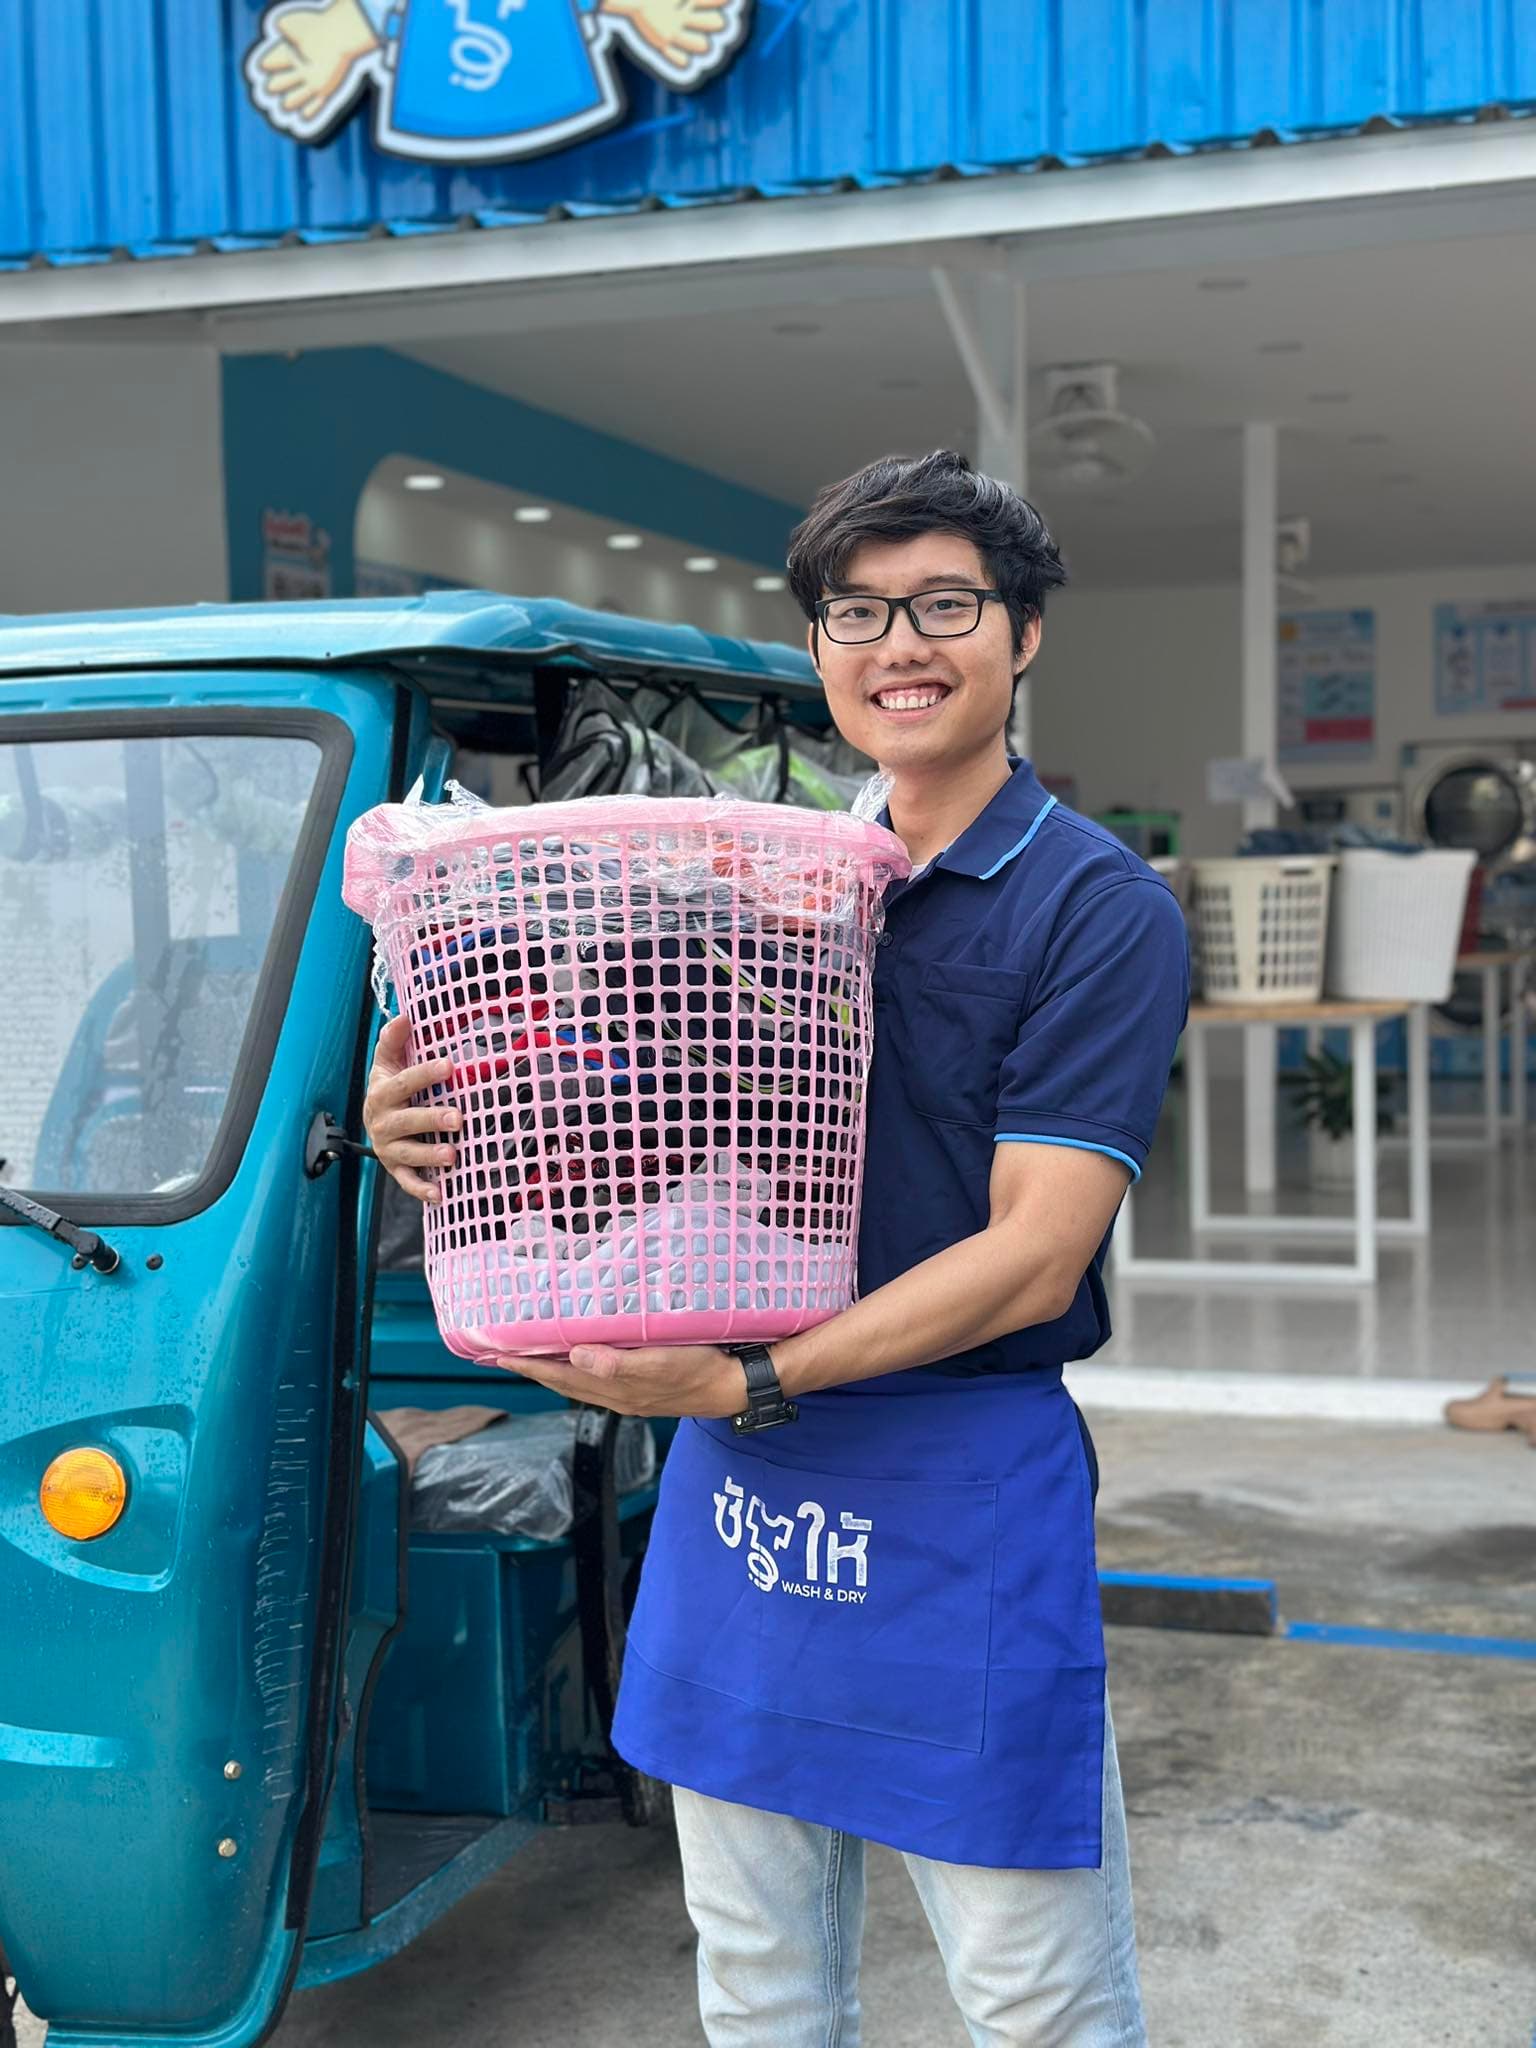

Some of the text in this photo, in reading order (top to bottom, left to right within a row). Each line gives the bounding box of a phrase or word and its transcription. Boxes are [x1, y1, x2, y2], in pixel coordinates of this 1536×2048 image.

[781, 1580, 867, 1604] WASH & DRY
